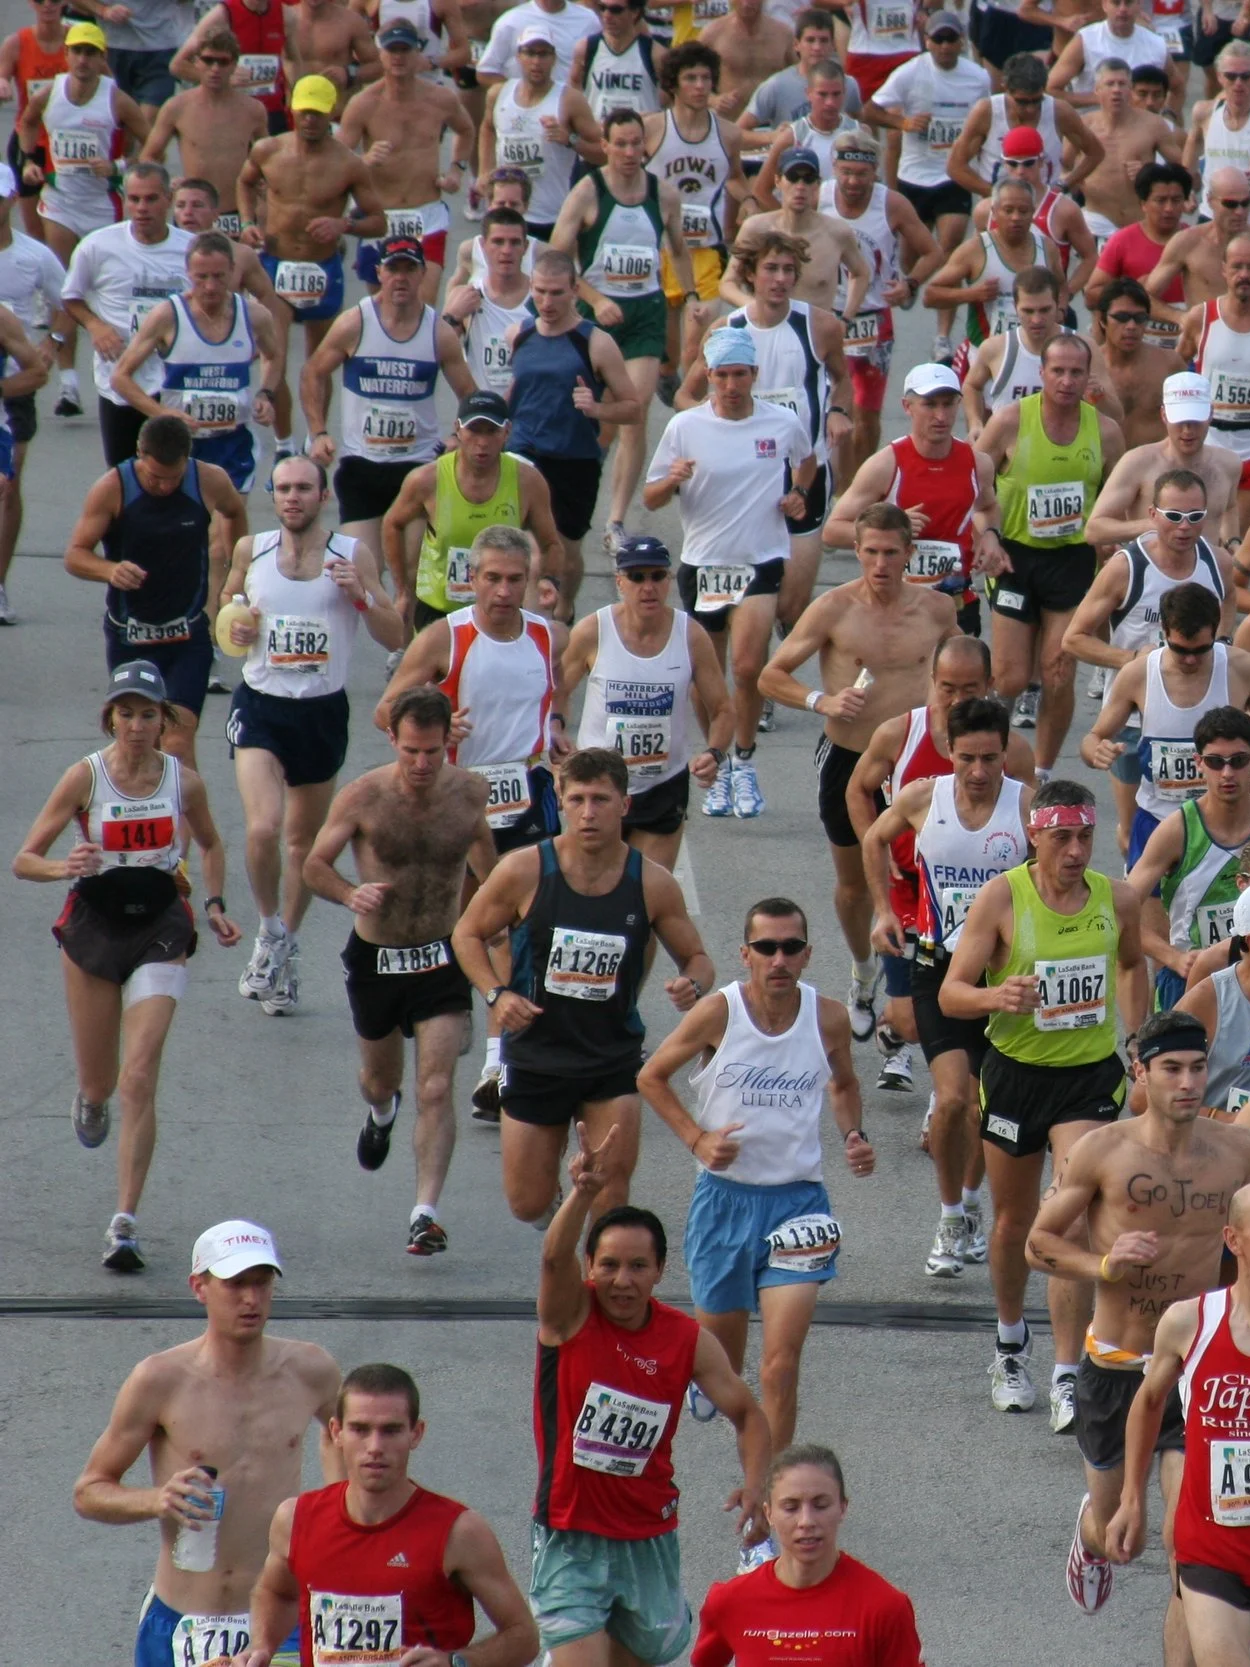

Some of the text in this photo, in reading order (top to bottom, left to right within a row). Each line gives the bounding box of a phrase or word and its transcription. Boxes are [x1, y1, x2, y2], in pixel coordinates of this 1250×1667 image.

[929, 129, 937, 142] A
[63, 139, 96, 158] 1186
[665, 156, 717, 182] IOWA
[605, 257, 651, 276] A 1005
[277, 277, 324, 293] A 1185
[484, 349, 492, 366] D
[199, 366, 226, 376] WEST
[376, 362, 416, 377] WEST
[359, 377, 428, 395] WATERFORD
[1173, 388, 1201, 398] TIMEX
[1215, 384, 1224, 400] A
[198, 403, 235, 422] 1398
[363, 419, 415, 439] A 1012
[1029, 495, 1082, 519] A 1063
[448, 564, 457, 580] A
[699, 572, 708, 591] A
[128, 622, 139, 641] A
[268, 629, 329, 654] A 1582
[608, 683, 671, 693] HEARTBREAK
[624, 692, 649, 700] HILL
[607, 706, 672, 716] BOSTON
[627, 695, 673, 708] STRIDERS
[615, 733, 665, 755] A 652
[1159, 757, 1169, 780] A
[121, 823, 158, 848] 141
[944, 905, 955, 929] A
[1208, 922, 1219, 944] A
[378, 942, 441, 972] A 1857
[549, 946, 620, 976] A 1266
[1037, 973, 1104, 1005] A 1067
[715, 1062, 817, 1091] Michelob
[741, 1092, 803, 1107] ULTRA
[997, 1126, 1007, 1136] 16
[223, 1234, 270, 1247] TIMEX
[773, 1221, 841, 1252] A 1349
[613, 1399, 658, 1417] LaSalle Bank
[579, 1404, 660, 1451] B 4391
[1220, 1463, 1236, 1495] A
[313, 1615, 398, 1653] A 1297
[742, 1628, 856, 1641] rungazelle.com
[183, 1636, 196, 1667] A
